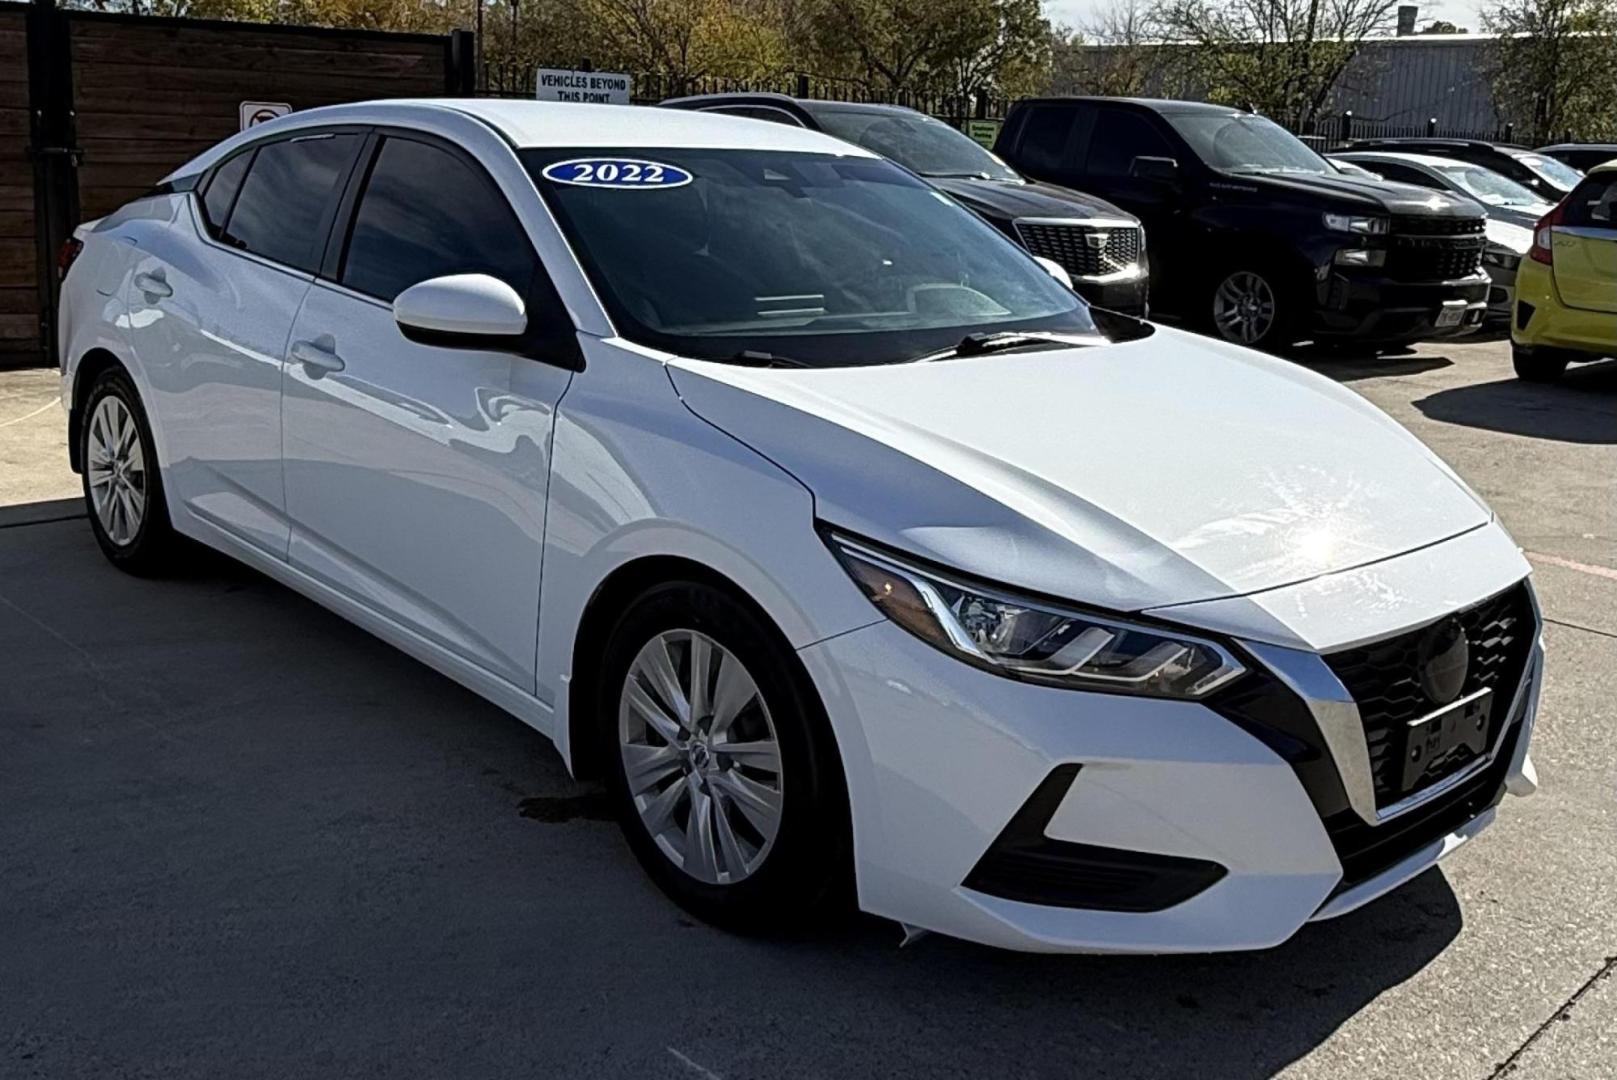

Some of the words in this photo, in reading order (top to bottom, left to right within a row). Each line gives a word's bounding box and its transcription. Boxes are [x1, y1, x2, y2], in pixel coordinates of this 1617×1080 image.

[541, 74, 588, 89] VEHICLES
[590, 77, 626, 91] BEYOND
[557, 91, 580, 102] THIS
[582, 92, 610, 103] POINT
[572, 164, 664, 182] 2022
